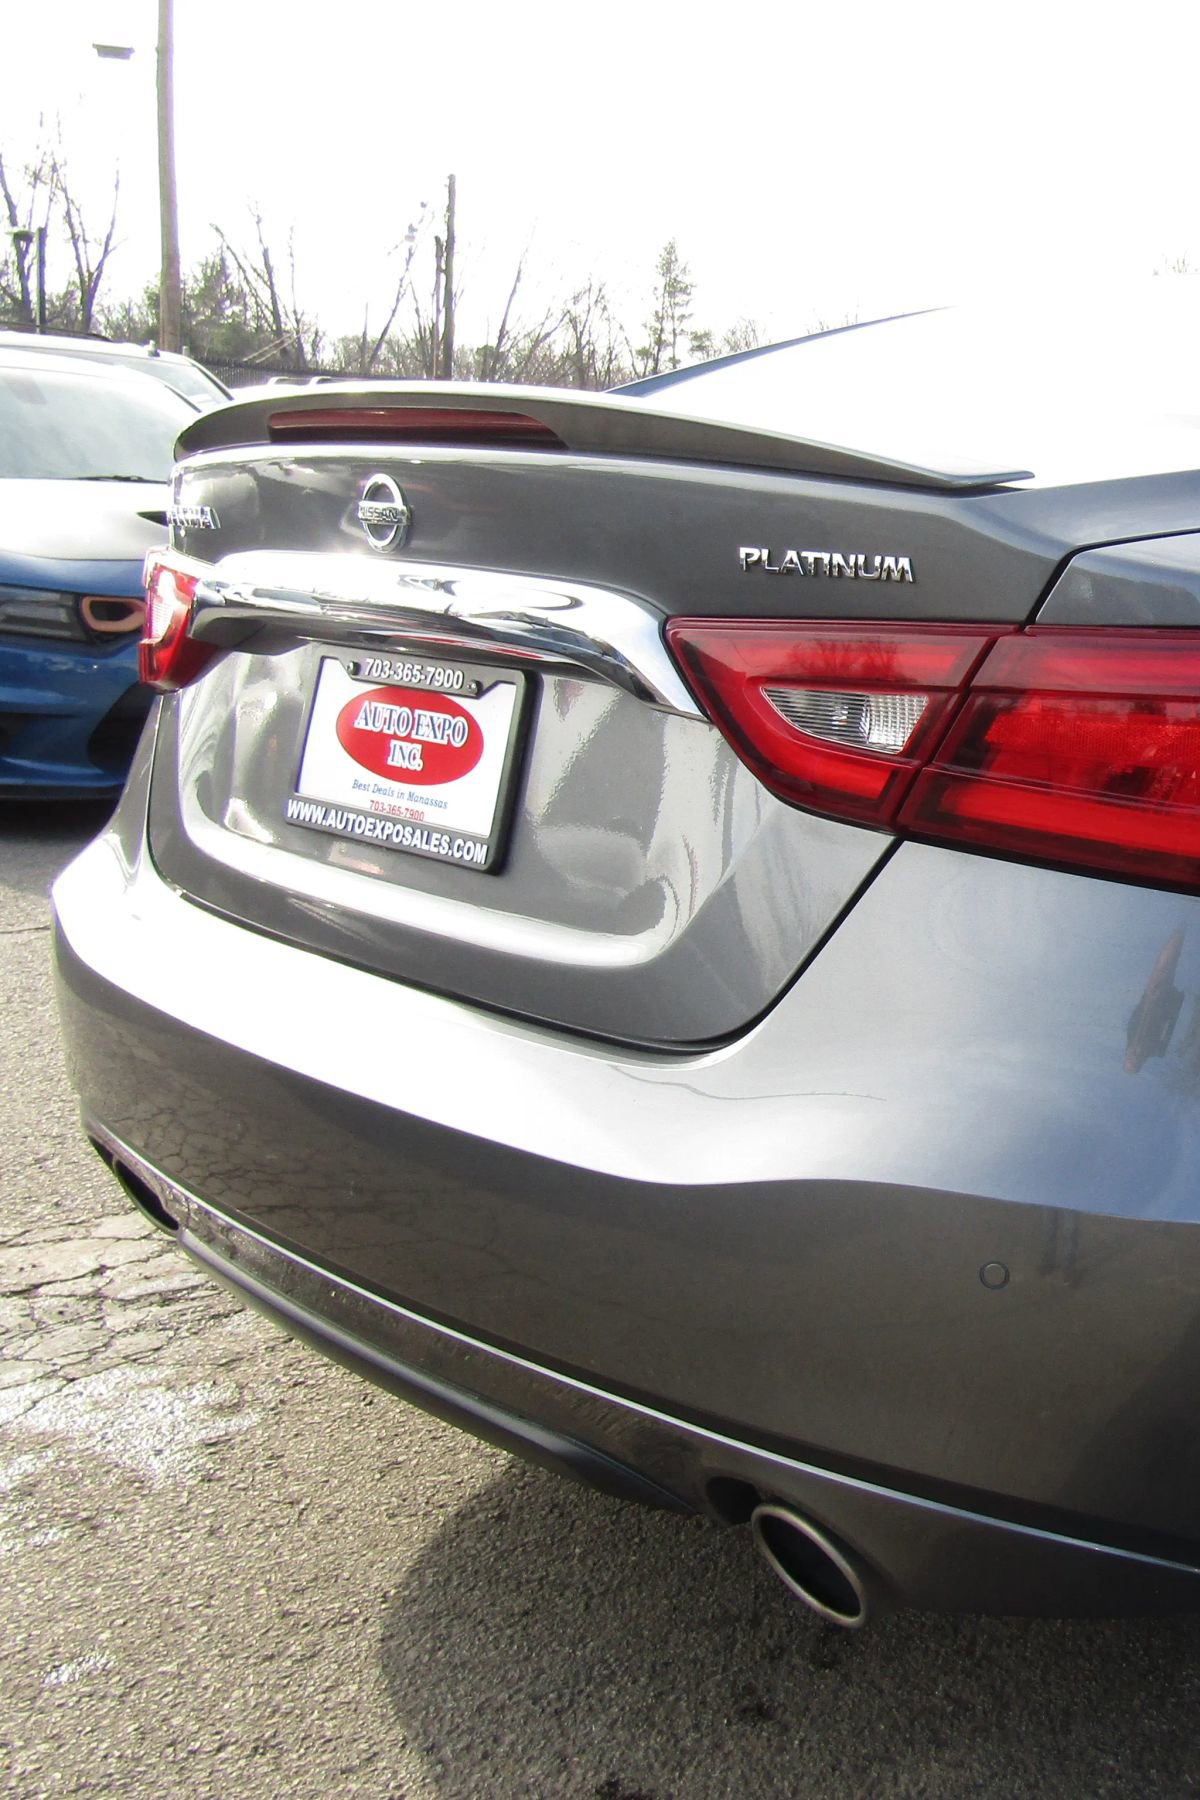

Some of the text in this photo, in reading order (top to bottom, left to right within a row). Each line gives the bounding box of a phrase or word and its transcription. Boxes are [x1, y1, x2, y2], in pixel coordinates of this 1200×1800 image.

[739, 547, 914, 583] PLATINUM
[365, 658, 464, 689] 703-365-7900
[355, 701, 468, 746] AUTO EXPO
[388, 741, 424, 771] INC.
[352, 779, 449, 809] Best Deals in Manassas
[369, 799, 425, 821] 703-365-7900
[287, 799, 489, 864] WWW.AUTOEXPOSALES.COM
